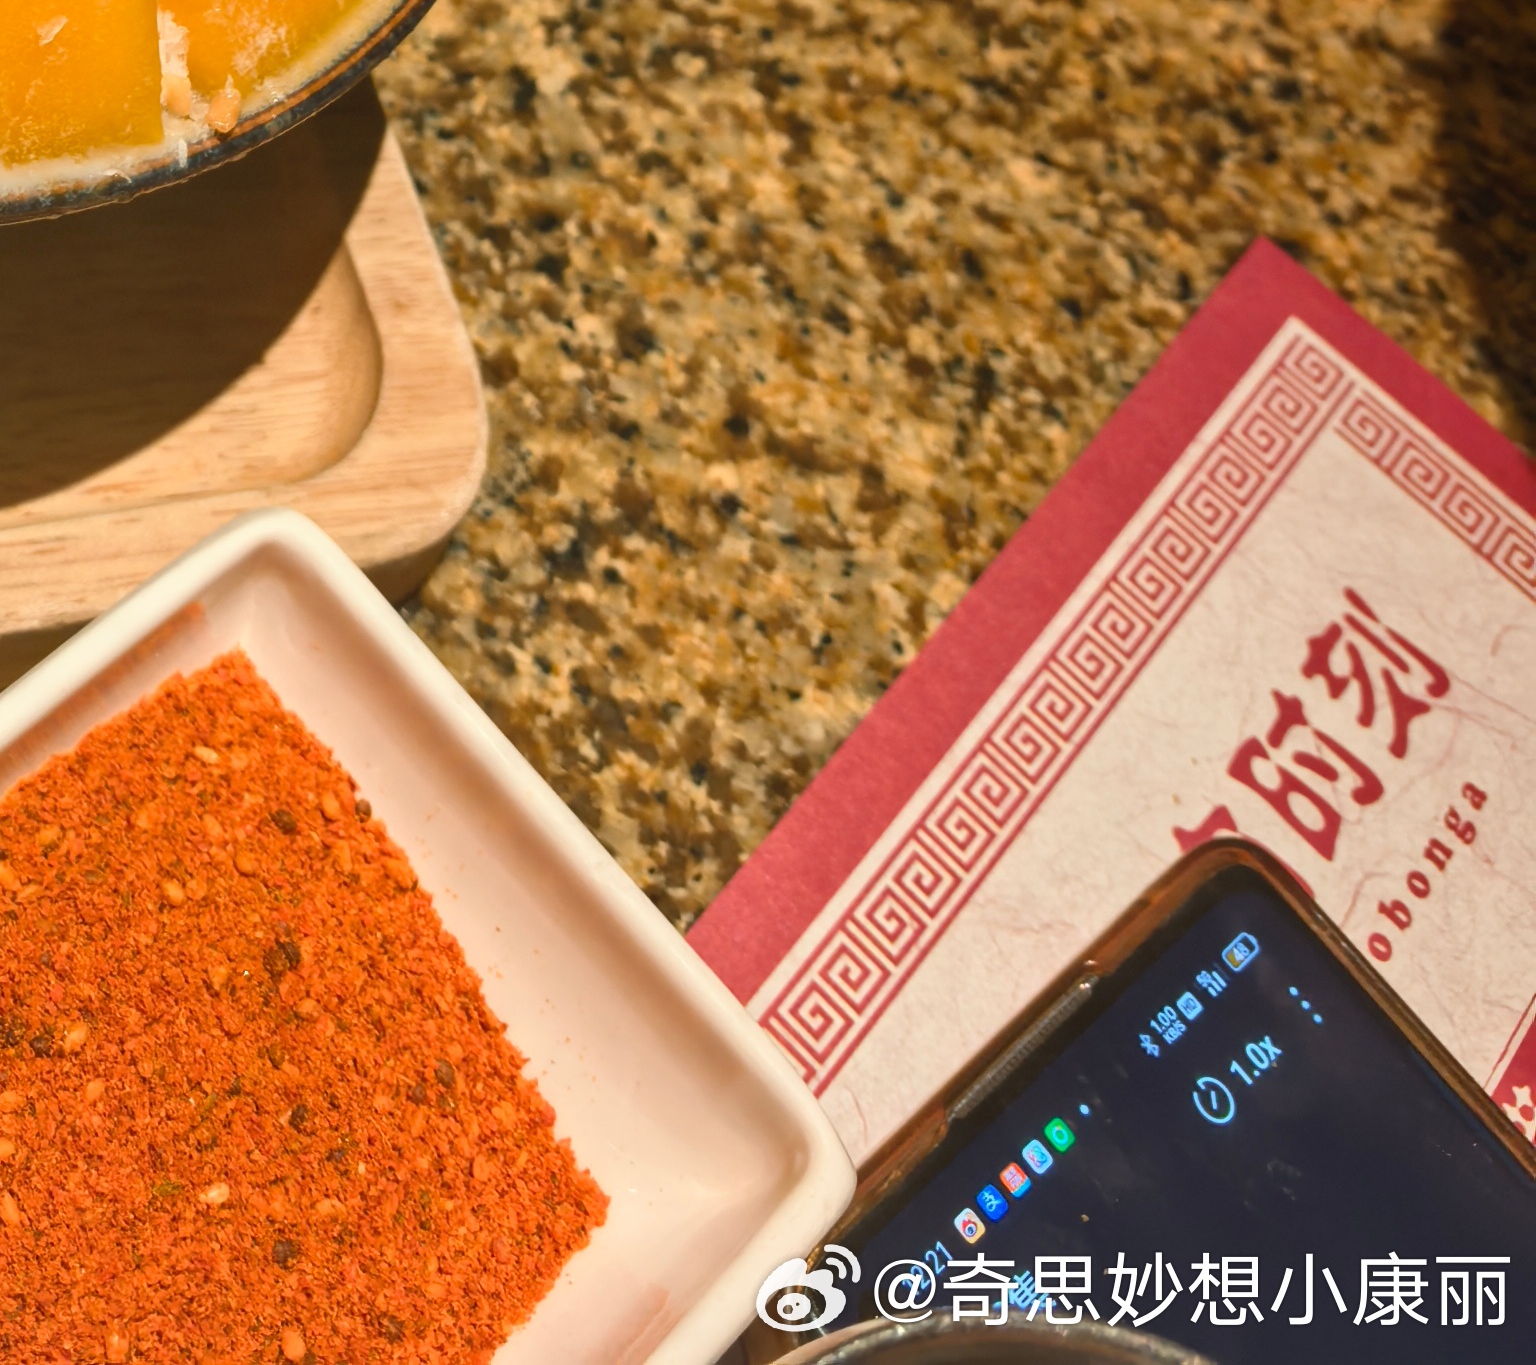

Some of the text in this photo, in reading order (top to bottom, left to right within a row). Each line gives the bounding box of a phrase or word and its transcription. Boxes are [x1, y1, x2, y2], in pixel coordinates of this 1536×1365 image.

[1172, 587, 1450, 897] 时刻
[1367, 781, 1487, 962] obonga
[1230, 1035, 1282, 1085] 1.0x
